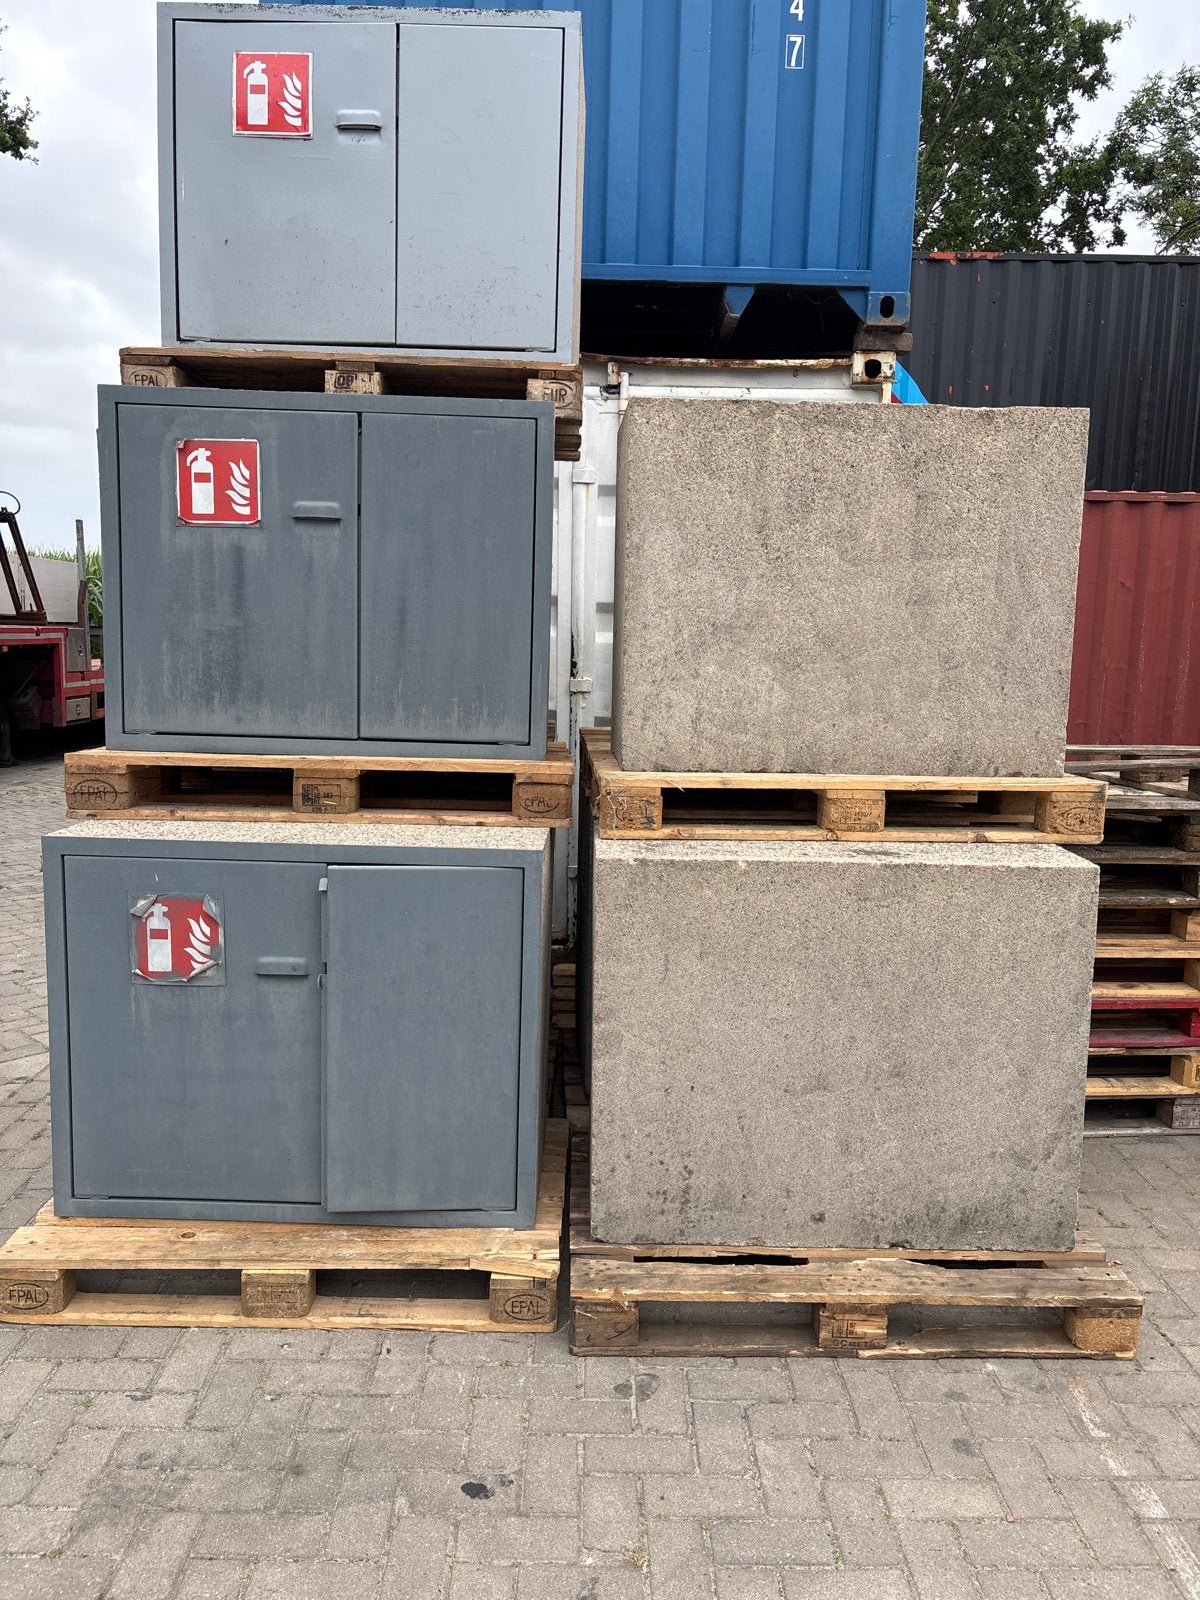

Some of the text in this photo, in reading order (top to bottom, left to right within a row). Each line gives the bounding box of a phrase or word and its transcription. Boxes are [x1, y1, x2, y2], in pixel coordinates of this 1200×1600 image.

[789, 0, 804, 22] 4
[789, 36, 803, 67] 7
[511, 1300, 545, 1315] EPAL
